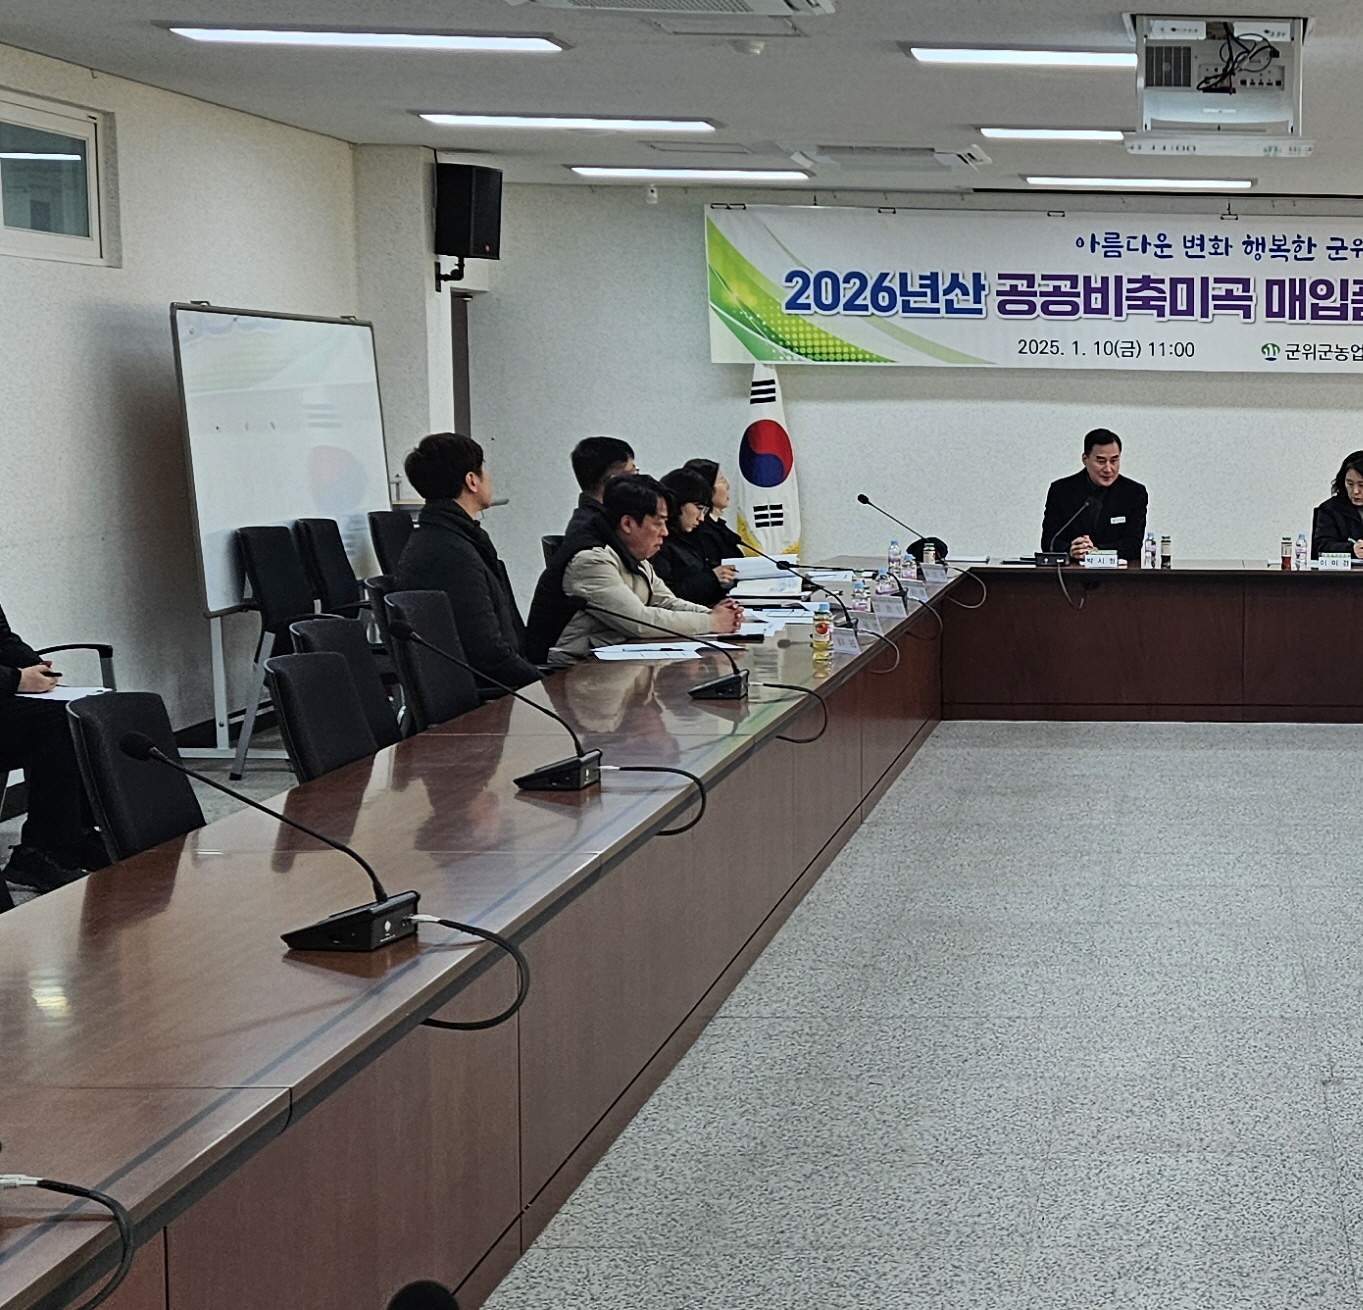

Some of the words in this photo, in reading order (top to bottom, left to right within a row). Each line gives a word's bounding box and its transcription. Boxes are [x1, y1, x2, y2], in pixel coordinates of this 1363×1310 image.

[1075, 231, 1174, 259] 아름다운
[1182, 233, 1234, 259] 변화
[1241, 233, 1318, 262] 행복한
[783, 270, 987, 317] 2026년산
[996, 272, 1255, 321] 공공비축미곡
[1017, 338, 1065, 356] 2025.
[1071, 340, 1087, 356] 1.
[1093, 339, 1142, 359] 10(금)
[1148, 341, 1196, 358] 11:00
